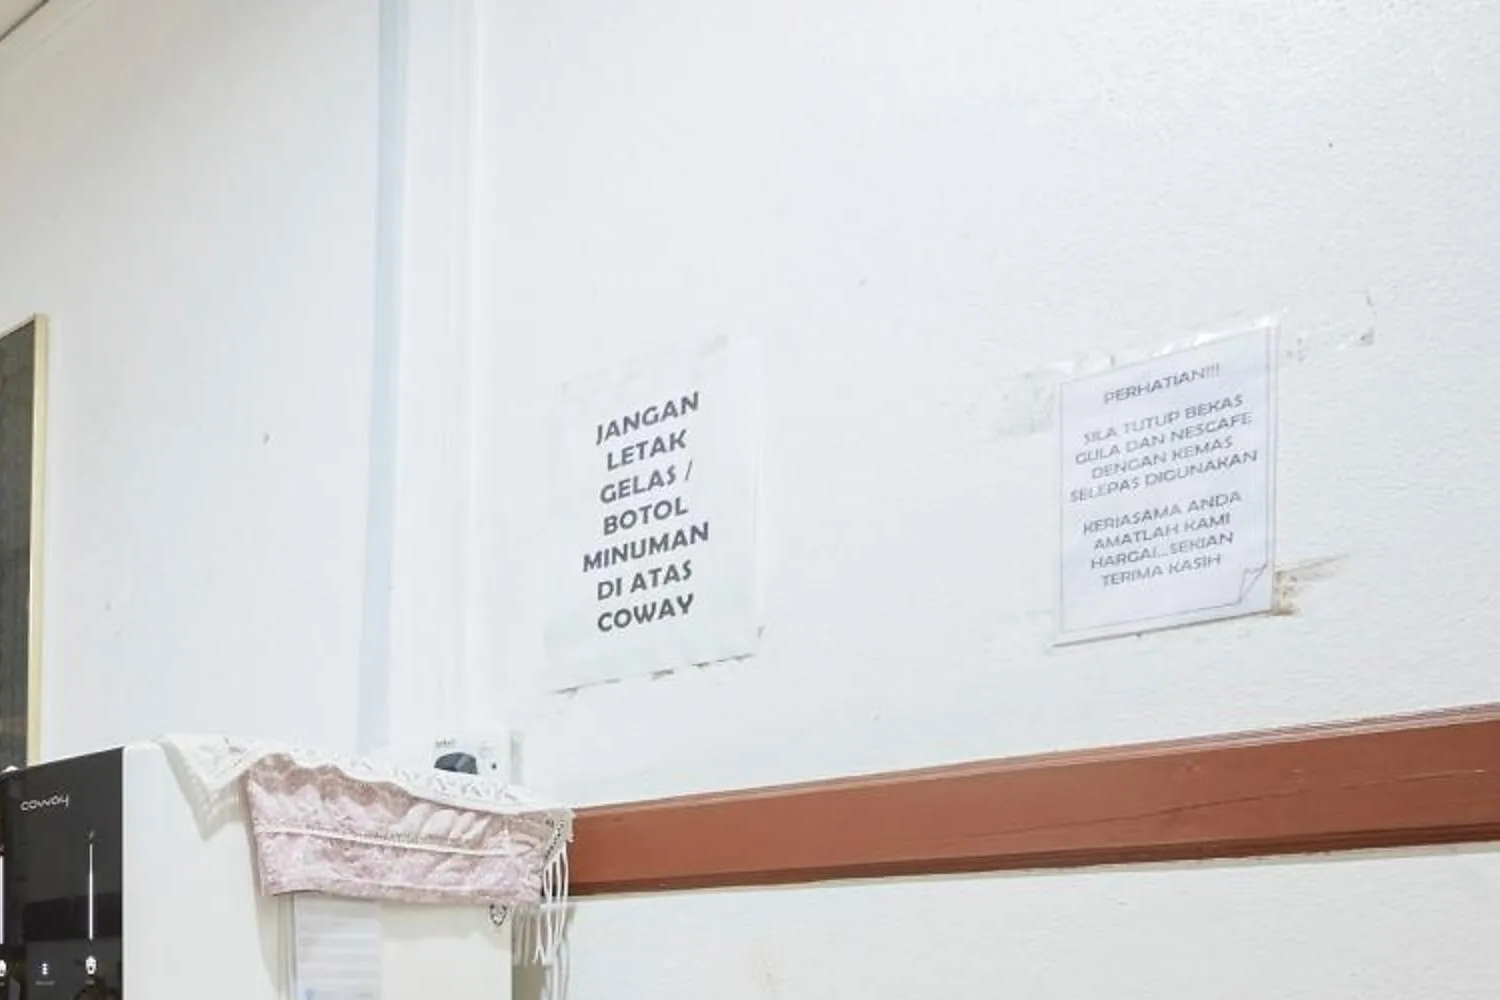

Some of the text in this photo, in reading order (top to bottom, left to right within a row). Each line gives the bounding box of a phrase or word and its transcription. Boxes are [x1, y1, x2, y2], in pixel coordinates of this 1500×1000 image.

[1104, 363, 1220, 404] PERHATIAN!!!
[596, 391, 699, 445] JANGAN
[1075, 411, 1253, 465] GULA DAN NESCAFE
[1084, 394, 1244, 446] SILA TUTUP BEKAS
[607, 429, 687, 472] LETAK
[1091, 435, 1233, 480] DENGAN KEMAS
[601, 458, 693, 504] GELAS /
[1070, 450, 1258, 503] SELEPAS DIGUNAKAN
[603, 497, 689, 536] BOTOL
[1187, 490, 1242, 513] ANDA
[582, 522, 709, 573] MINUMAN
[1093, 512, 1231, 551] AMATLAH KAMI
[598, 560, 693, 602] DI ATAS
[1101, 553, 1221, 587] TERIMA KASIH
[597, 593, 694, 633] COWAY
